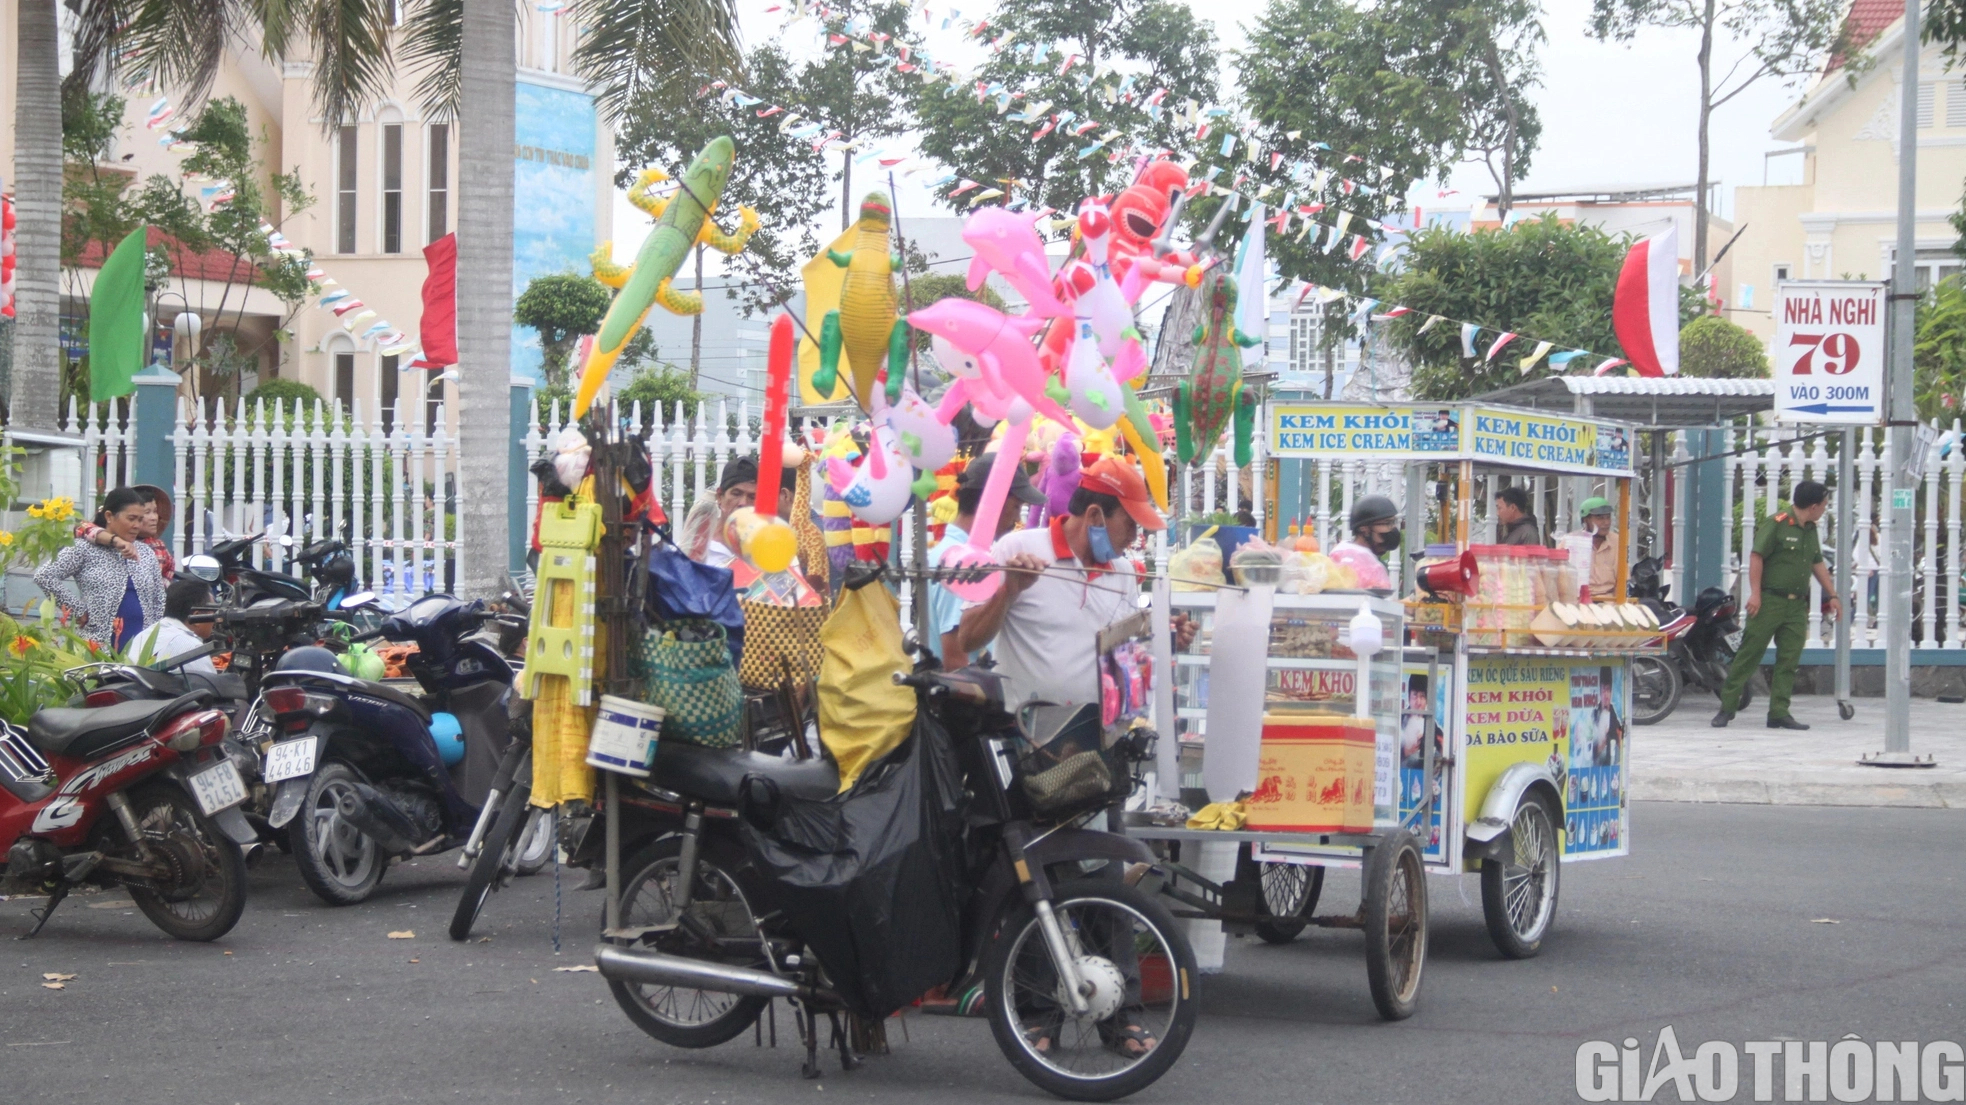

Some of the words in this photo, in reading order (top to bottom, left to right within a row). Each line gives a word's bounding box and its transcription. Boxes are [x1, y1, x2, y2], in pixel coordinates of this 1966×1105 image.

[1784, 291, 1823, 325] NHÀ
[1829, 288, 1878, 325] NGHỈ
[1788, 331, 1861, 376] 79
[1790, 382, 1820, 400] VÀO
[1825, 386, 1870, 400] 300M
[1279, 415, 1336, 429] KEM
[1345, 412, 1410, 429] KHÓI
[1476, 416, 1522, 436] KEM
[1527, 422, 1577, 443] KHÓI
[1279, 432, 1316, 450] KEM
[1319, 432, 1349, 449] ICE
[1351, 432, 1411, 450] CREAM
[1475, 436, 1506, 456] KEM
[1511, 440, 1535, 459] ICE
[1537, 445, 1586, 465] CREAM
[1281, 670, 1314, 692] KEM
[1467, 691, 1502, 704] KEM
[1508, 688, 1554, 703] KHÓI
[1466, 712, 1501, 725] KEM
[1506, 708, 1545, 723] DỪA
[1487, 730, 1517, 745] BÀO
[1521, 728, 1549, 743] SỮA
[275, 740, 308, 762] 94-K1
[196, 763, 234, 792] 94-F8
[268, 756, 312, 780] 448.46
[205, 782, 242, 812] 3454
